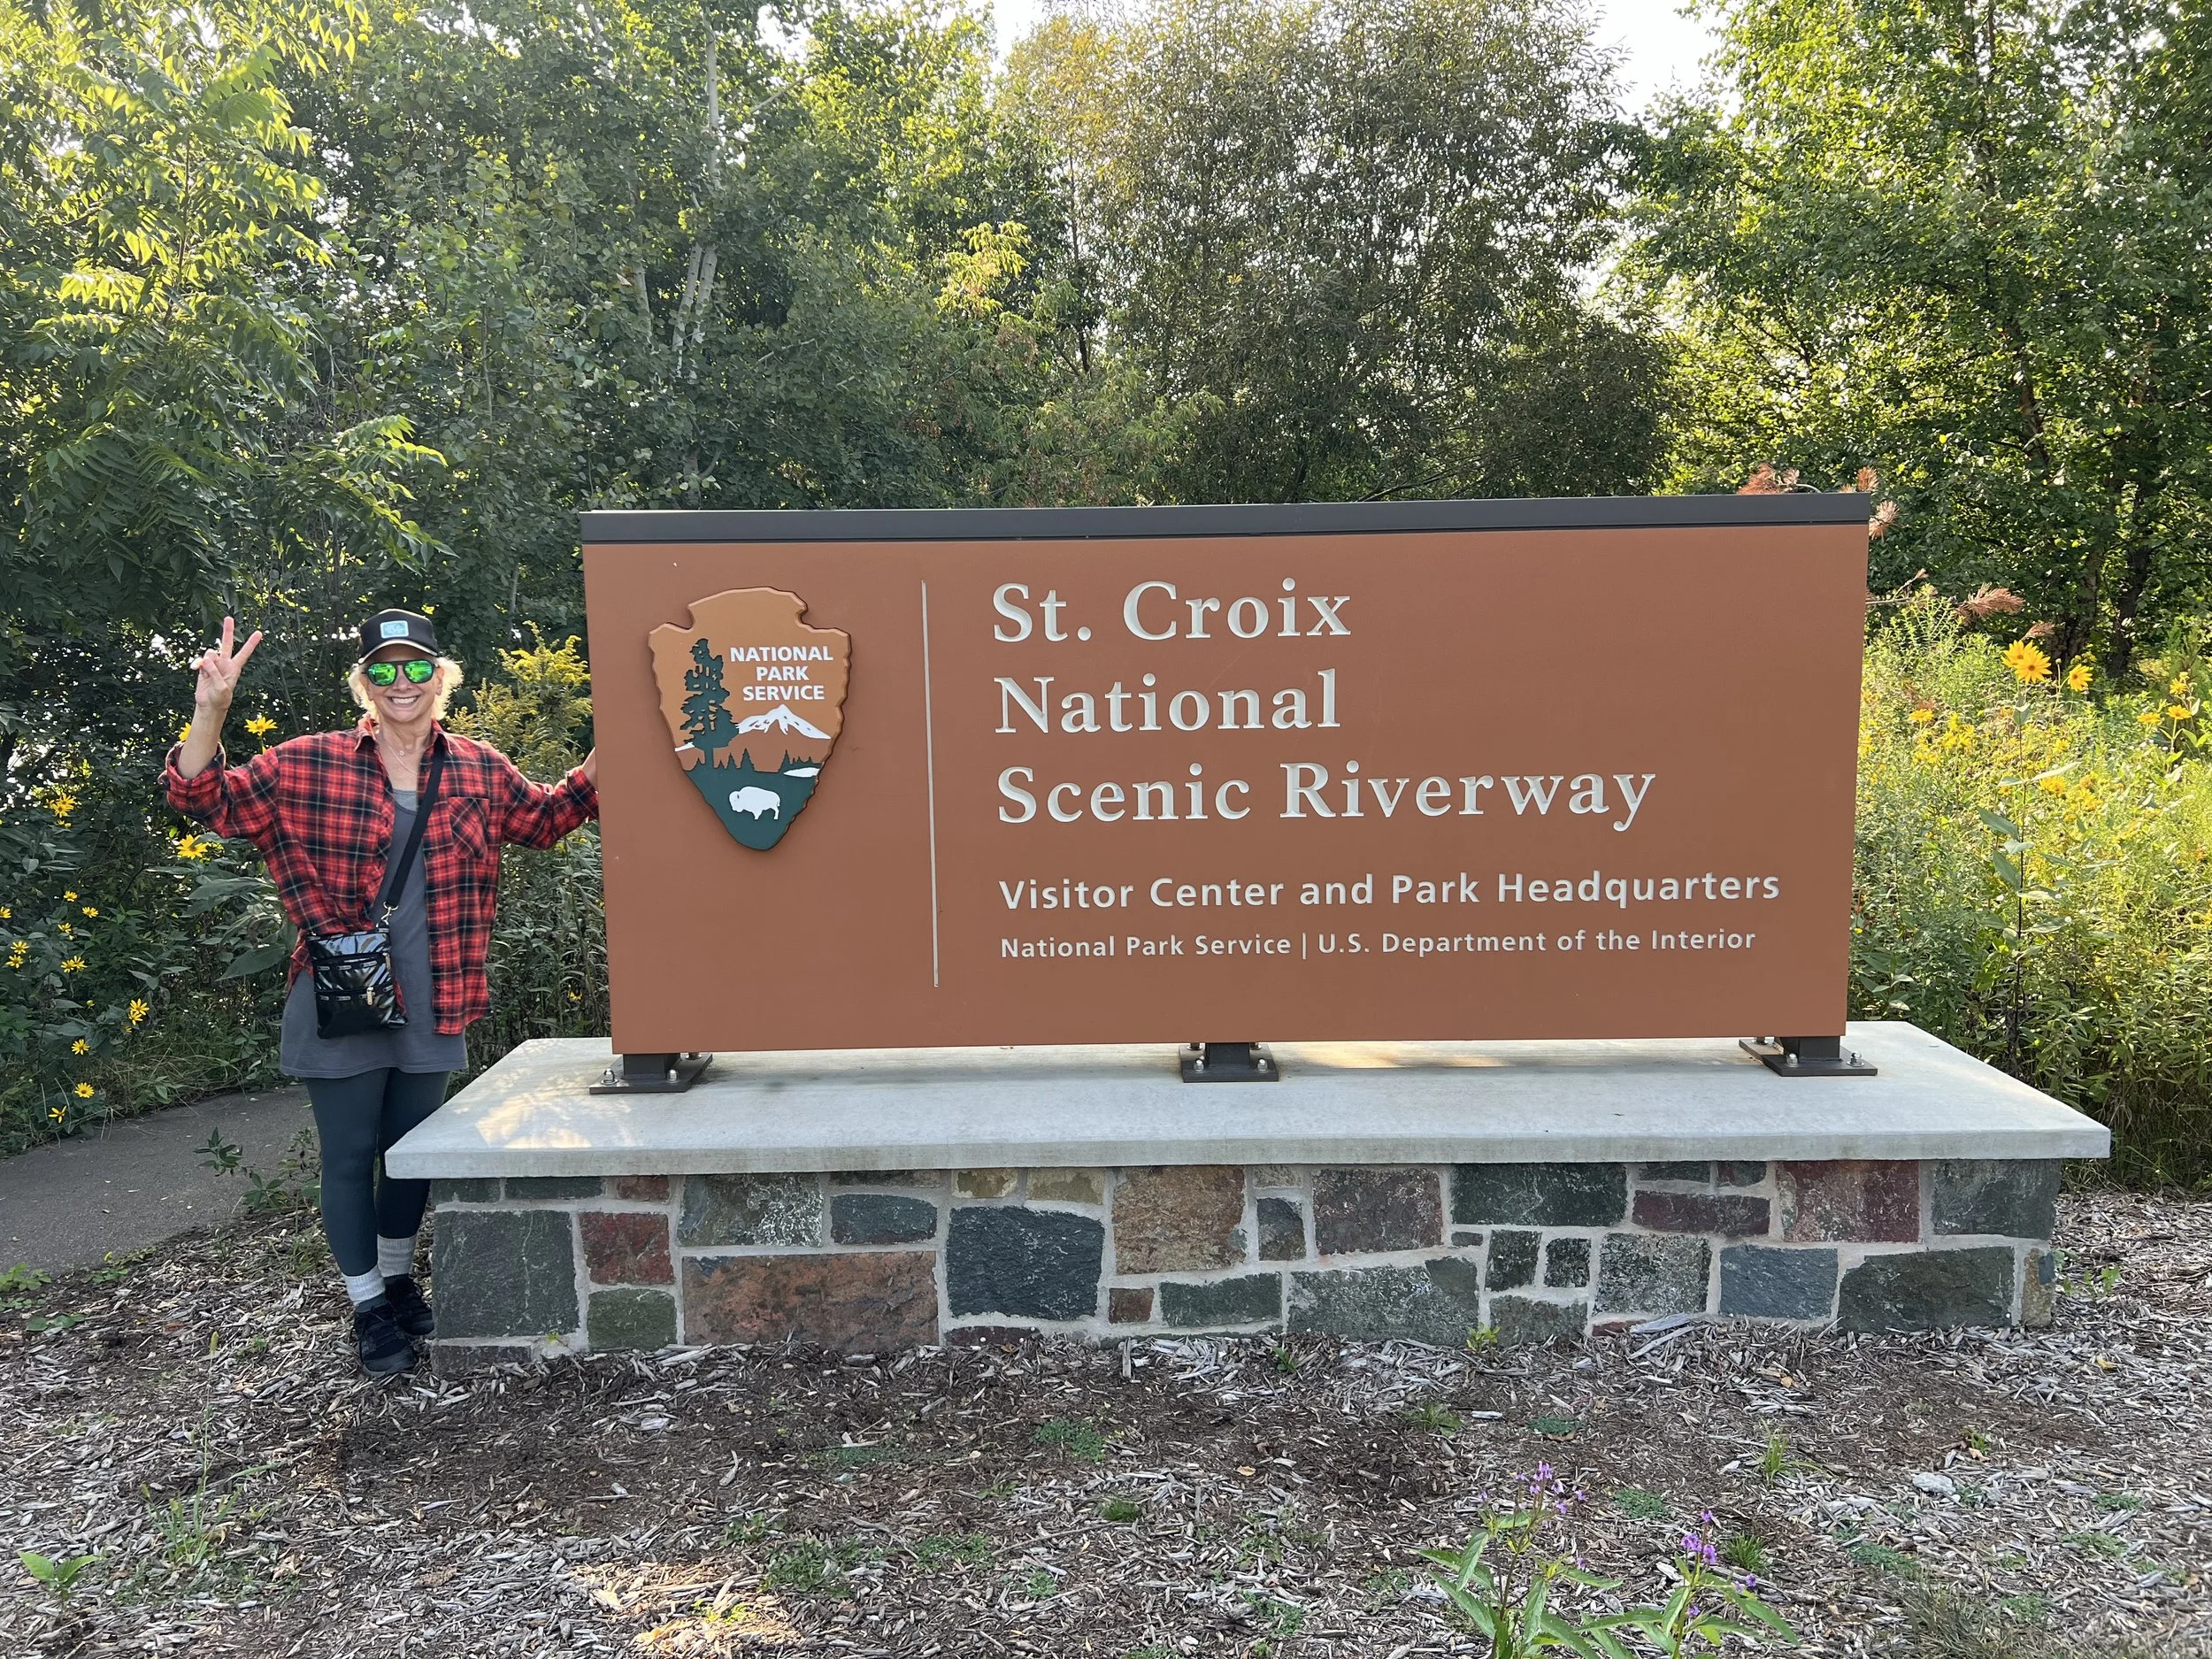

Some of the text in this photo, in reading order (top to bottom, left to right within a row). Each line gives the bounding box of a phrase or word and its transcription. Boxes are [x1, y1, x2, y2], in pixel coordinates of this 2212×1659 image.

[993, 577, 1352, 642] St. Croix
[730, 645, 834, 663] NATIONAL
[756, 666, 810, 681] PARK
[742, 685, 826, 702] SERVICE
[994, 668, 1341, 734] National
[997, 760, 1656, 832] Scenic Riverway
[999, 870, 1780, 910] Visitor Center and Park Headquarters
[1001, 928, 1756, 958] National Park Service U.S. Department of the Interior
